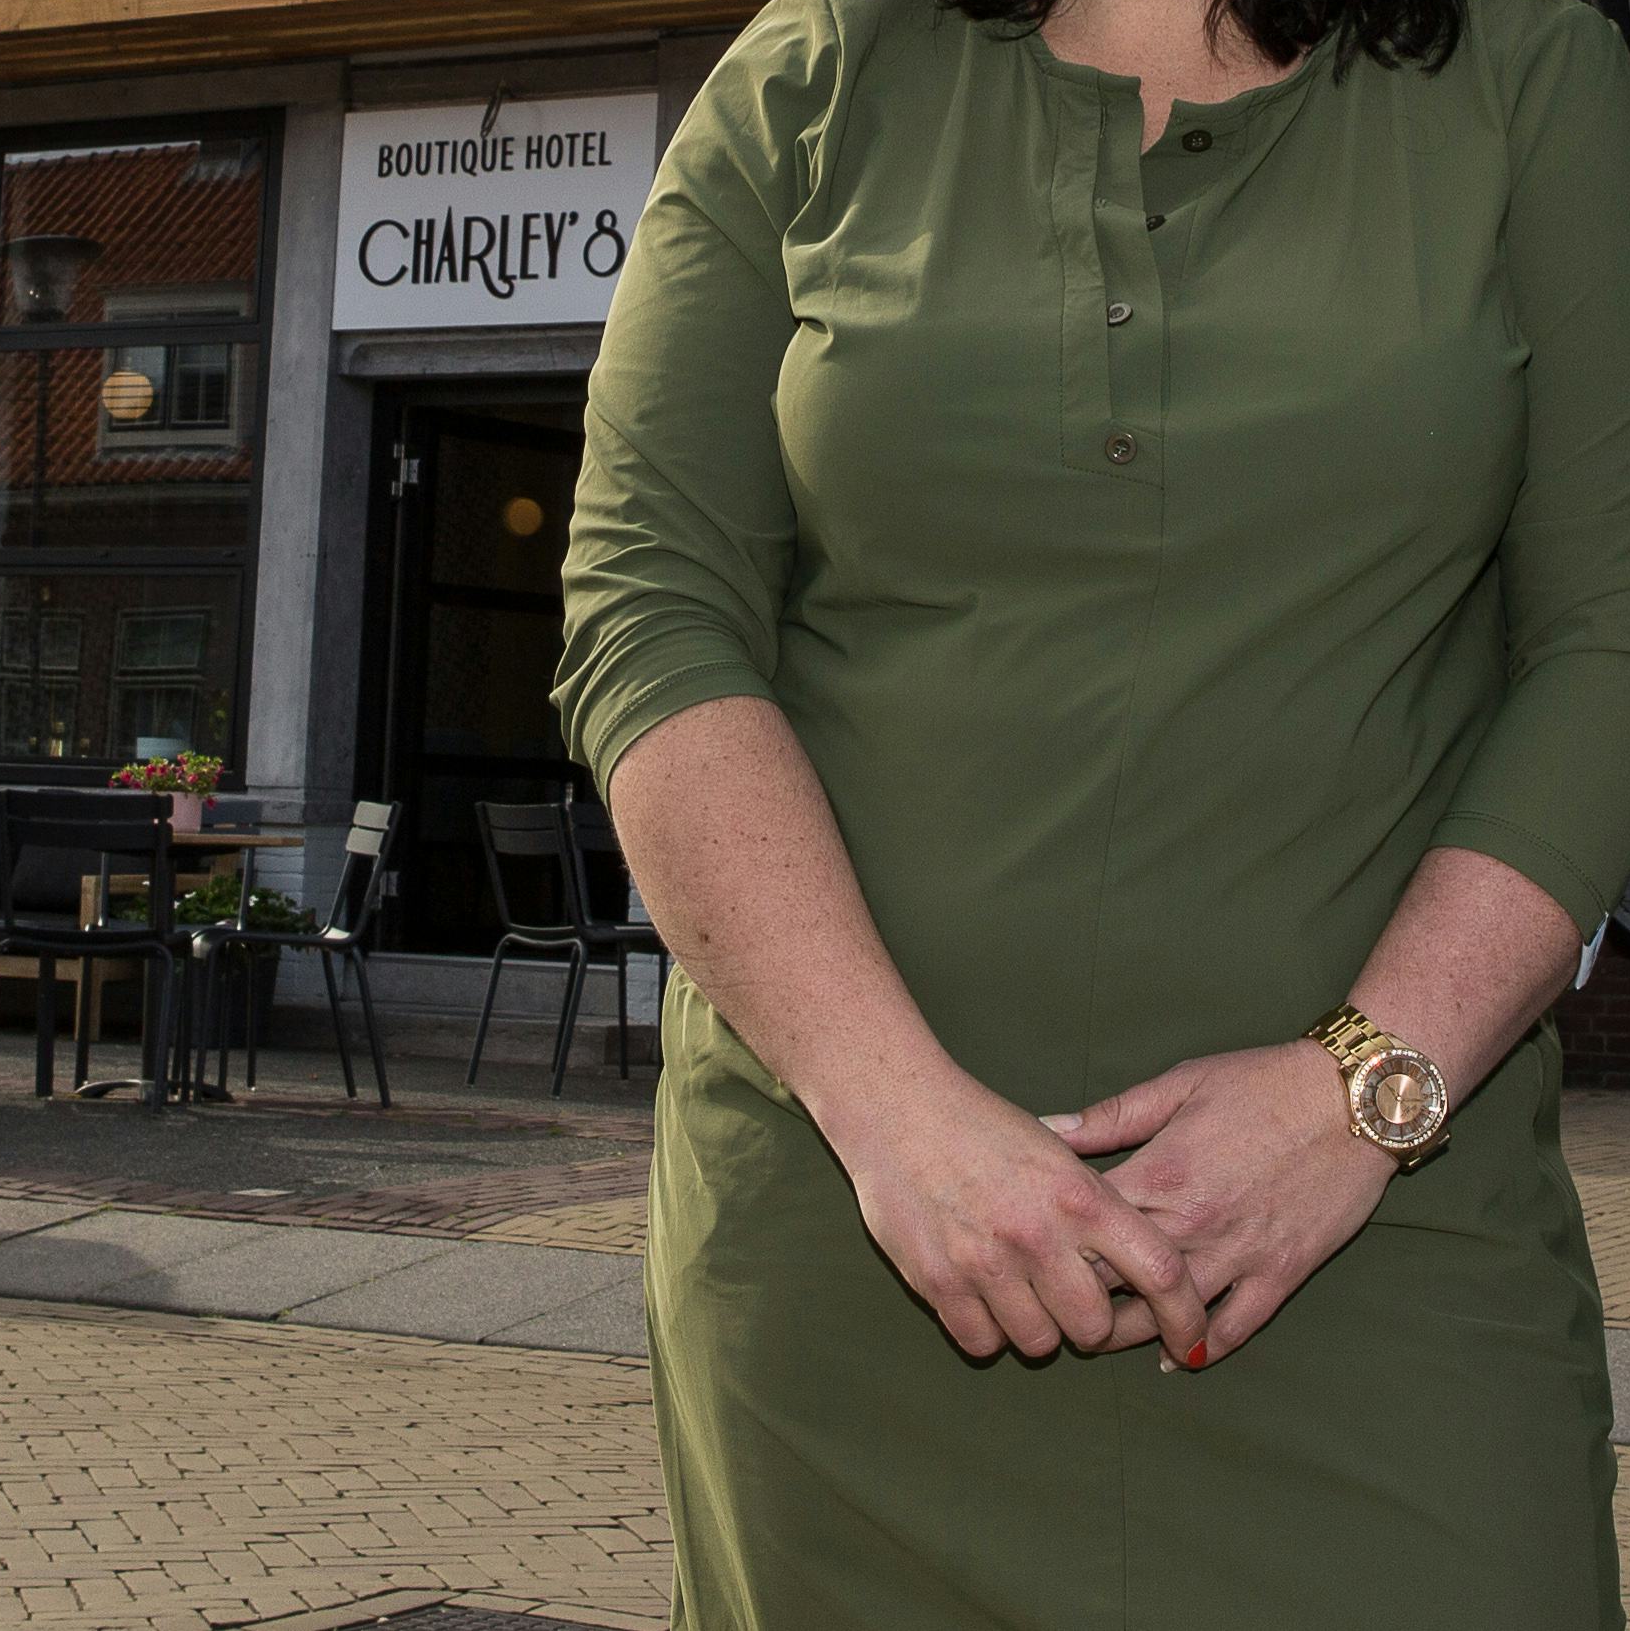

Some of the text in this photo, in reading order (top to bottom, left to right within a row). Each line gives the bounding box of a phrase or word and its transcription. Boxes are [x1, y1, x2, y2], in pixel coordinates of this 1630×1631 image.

[377, 131, 613, 178] BOUTIQUE HOTEL
[357, 205, 627, 300] CHARLEY'S
